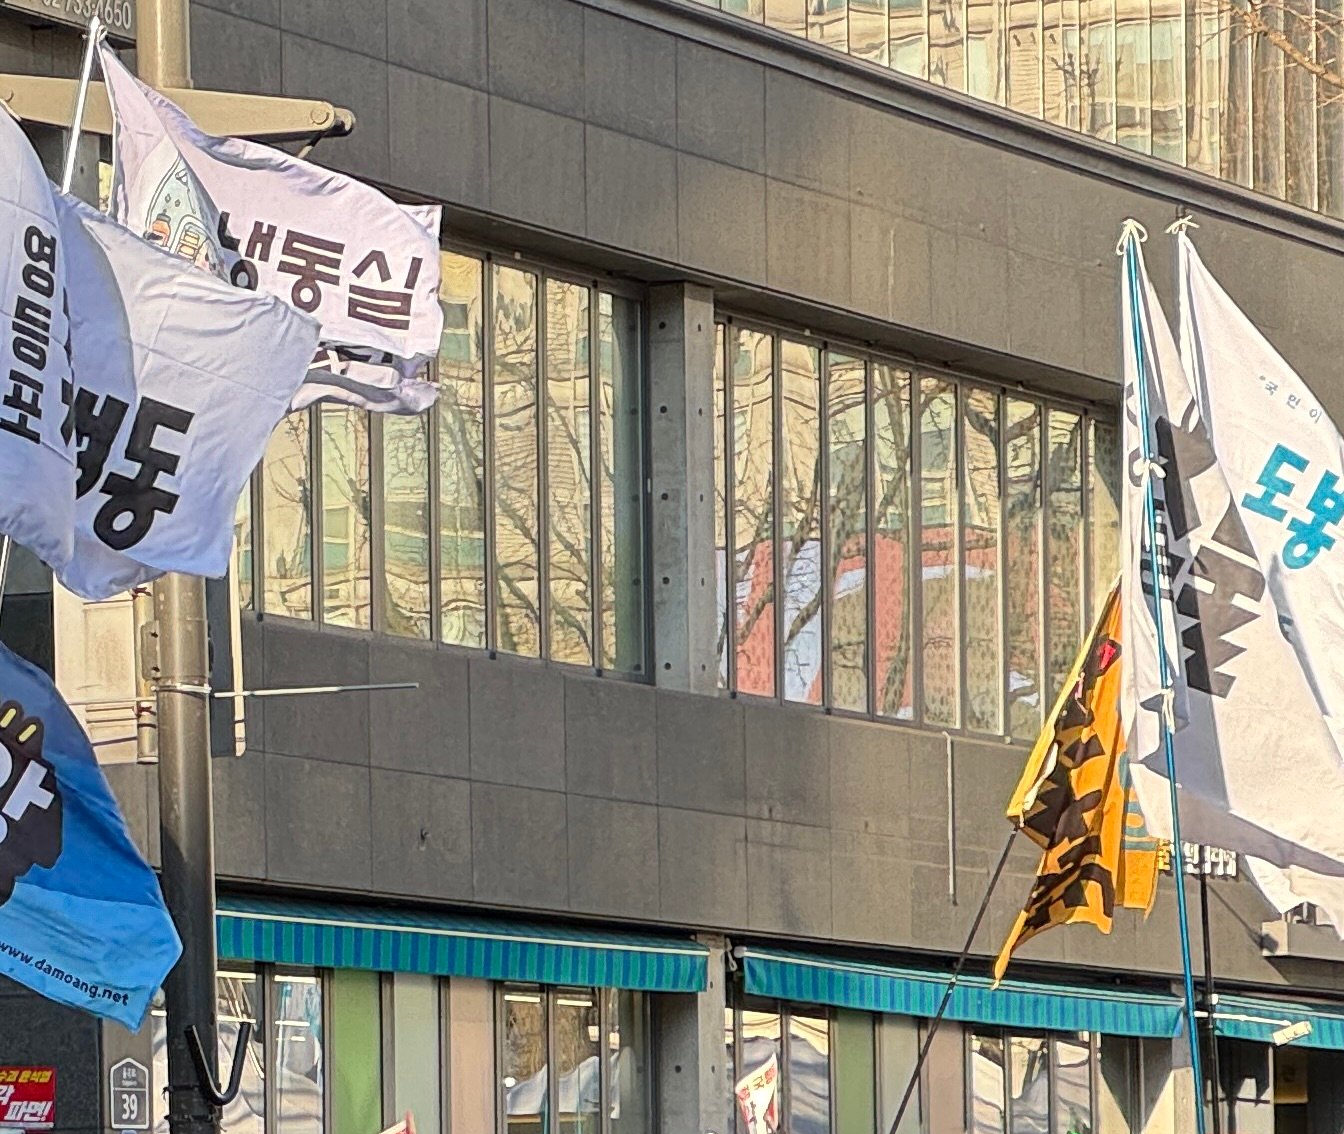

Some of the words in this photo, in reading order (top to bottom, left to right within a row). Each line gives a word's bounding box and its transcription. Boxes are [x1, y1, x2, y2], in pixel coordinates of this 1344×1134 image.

[218, 212, 423, 331] 냉동실
[4, 1101, 53, 1121] 파면!
[122, 1094, 138, 1120] 39
